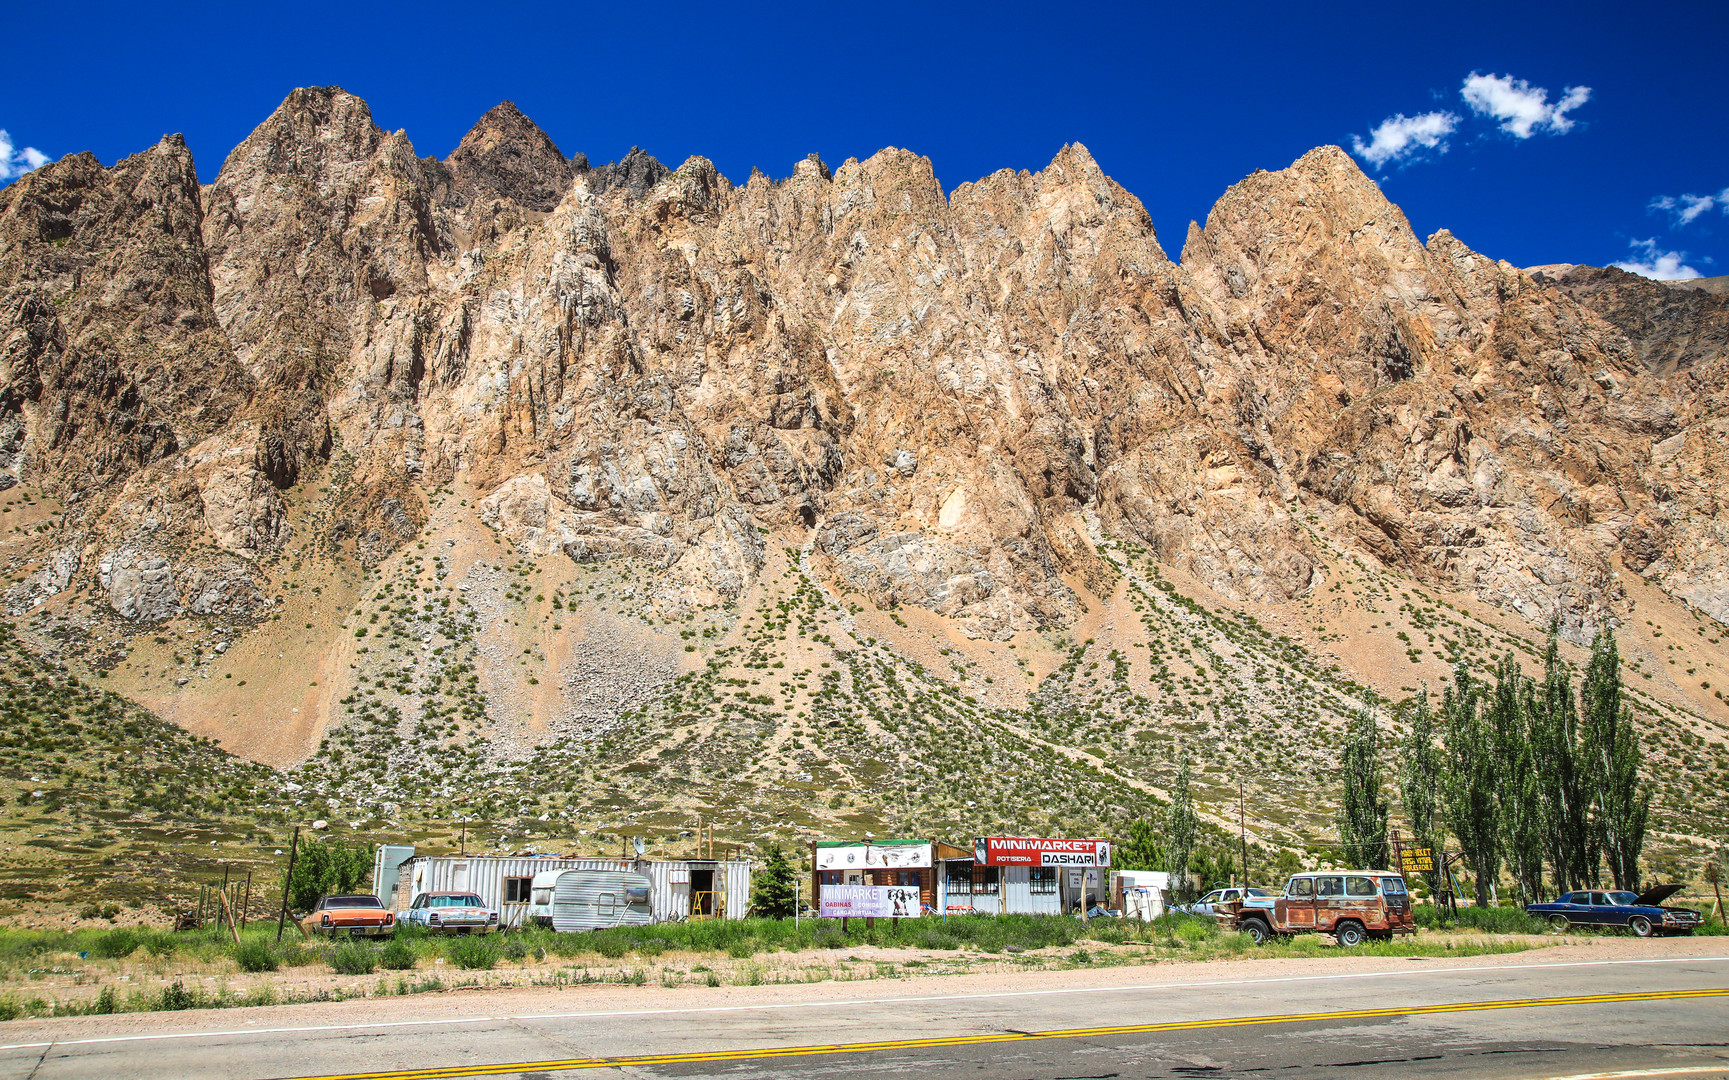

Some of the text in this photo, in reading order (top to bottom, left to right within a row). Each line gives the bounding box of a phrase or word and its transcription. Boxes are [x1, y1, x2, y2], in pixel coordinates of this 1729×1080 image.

[991, 840, 1093, 851] MINIMARKET
[1042, 854, 1094, 864] DASHARI
[824, 888, 883, 900] MINIMARKET
